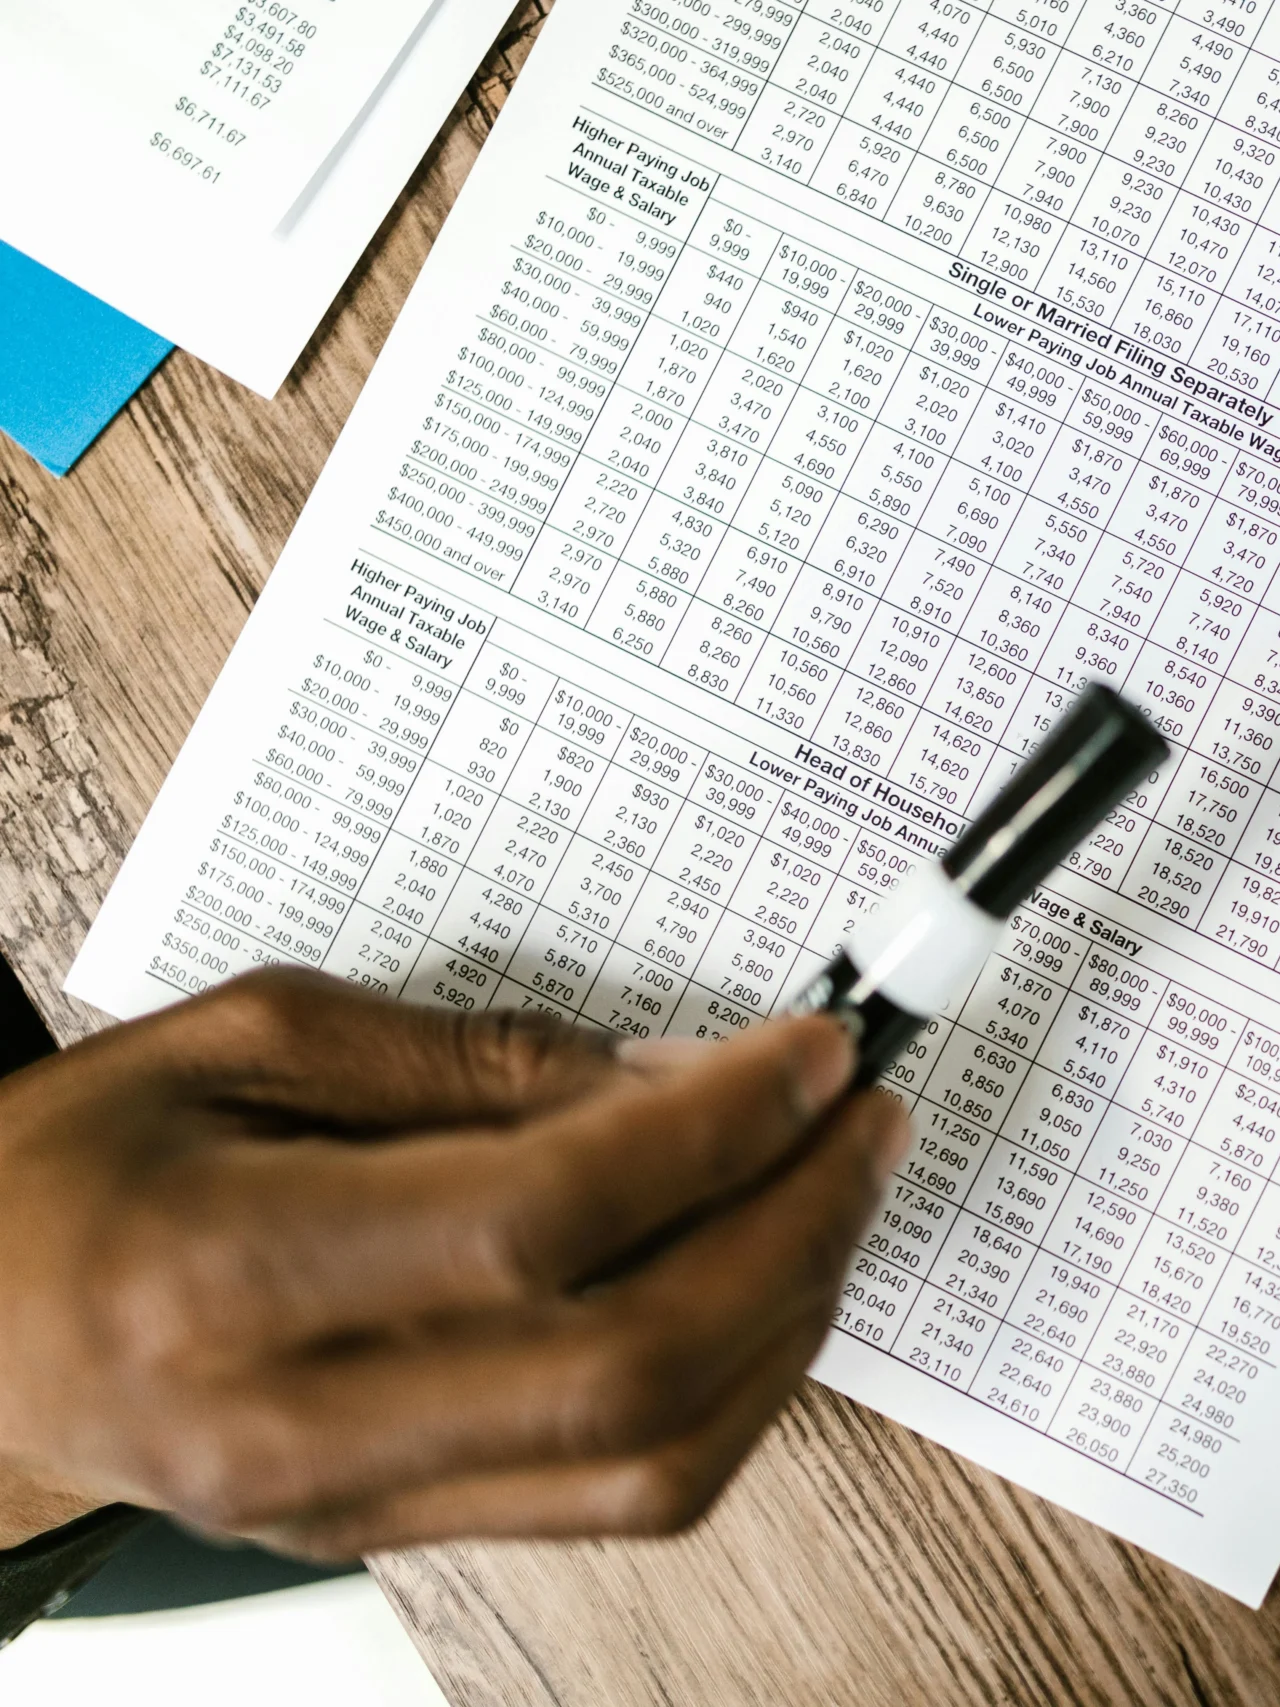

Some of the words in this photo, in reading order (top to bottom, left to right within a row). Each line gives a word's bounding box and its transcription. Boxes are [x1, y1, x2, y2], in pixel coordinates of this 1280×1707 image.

[235, 6, 305, 57] $3,491.58
[247, 0, 317, 39] 3,607.80
[1103, 22, 1145, 48] 4,360
[1202, 9, 1245, 37] 3,490
[223, 24, 293, 75] $4,098.20
[818, 31, 860, 59] 2,040
[906, 44, 947, 71] 4,440
[1004, 32, 1046, 60] 5,930
[211, 42, 282, 93] $7,131.53
[200, 60, 271, 109] $7,111.67
[596, 67, 664, 109] $525,000
[665, 104, 695, 123] and
[696, 119, 729, 139] over
[1156, 102, 1198, 130] 8,260
[175, 96, 246, 146] $6,711.67
[149, 132, 220, 183] $6,697.61
[571, 115, 625, 149] Higher
[625, 142, 679, 180] Paying
[680, 170, 710, 192] Job
[572, 141, 629, 177] Annual
[631, 167, 689, 206] Taxable
[568, 161, 610, 193] Wage
[613, 185, 625, 201] &
[628, 192, 677, 226] Salary
[836, 182, 877, 210] 6,840
[1004, 203, 1052, 235] 10,980
[709, 233, 750, 261] 9,999
[706, 264, 744, 291] $440
[781, 300, 819, 326] $940
[948, 261, 1007, 300] Single
[1011, 294, 1034, 311] or
[1035, 301, 1113, 349] Married
[1113, 338, 1167, 378] Filing
[1170, 366, 1274, 427] Separately
[1133, 322, 1182, 354] 18,030
[756, 346, 795, 373] 1,620
[972, 302, 1026, 336] Lower
[1026, 328, 1083, 367] Paying
[1085, 357, 1117, 381] Job
[1118, 373, 1179, 410] Annual
[1182, 399, 1245, 441] Taxable
[1006, 376, 1057, 407] 49,999
[995, 402, 1046, 435] $1,410
[980, 455, 1023, 482] 4,100
[857, 511, 899, 540] 6,290
[375, 509, 442, 551] $450,000
[443, 546, 473, 566] and
[473, 561, 505, 581] over
[560, 543, 602, 571] 2,970
[659, 532, 701, 561] 5,320
[1122, 551, 1165, 580] 5,720
[350, 558, 402, 592] Higher
[403, 584, 455, 622] Paying
[457, 613, 486, 635] Job
[349, 584, 406, 619] Annual
[408, 610, 465, 649] Taxable
[345, 604, 387, 636] Wage
[389, 628, 402, 644] &
[404, 635, 453, 670] Salary
[687, 663, 729, 692] 8,830
[968, 653, 1017, 686] 12,600
[556, 746, 594, 773] $820
[793, 743, 848, 781] Head
[849, 775, 873, 792] of
[872, 781, 967, 839] Househol
[909, 772, 958, 804] 15,790
[1200, 766, 1250, 799] 16,500
[705, 787, 756, 820] 39,999
[748, 750, 802, 786] Lower
[802, 777, 859, 818] Paying
[861, 808, 892, 832] Job
[893, 824, 950, 858] Annua
[1072, 911, 1086, 929] &
[1089, 919, 1143, 957] Salary
[1137, 885, 1190, 919] 20,290
[457, 935, 499, 964] 4,440
[743, 928, 785, 958] 3,940
[432, 980, 475, 1011] 5,920
[1156, 1044, 1208, 1079] $1,910
[1038, 1107, 1082, 1137] 9,050
[907, 1161, 957, 1195] 14,690
[957, 1249, 1010, 1284] 20,390
[986, 1387, 1040, 1421] 24,610
[1181, 1393, 1234, 1428] 24,980
[1066, 1427, 1118, 1462] 26,050
